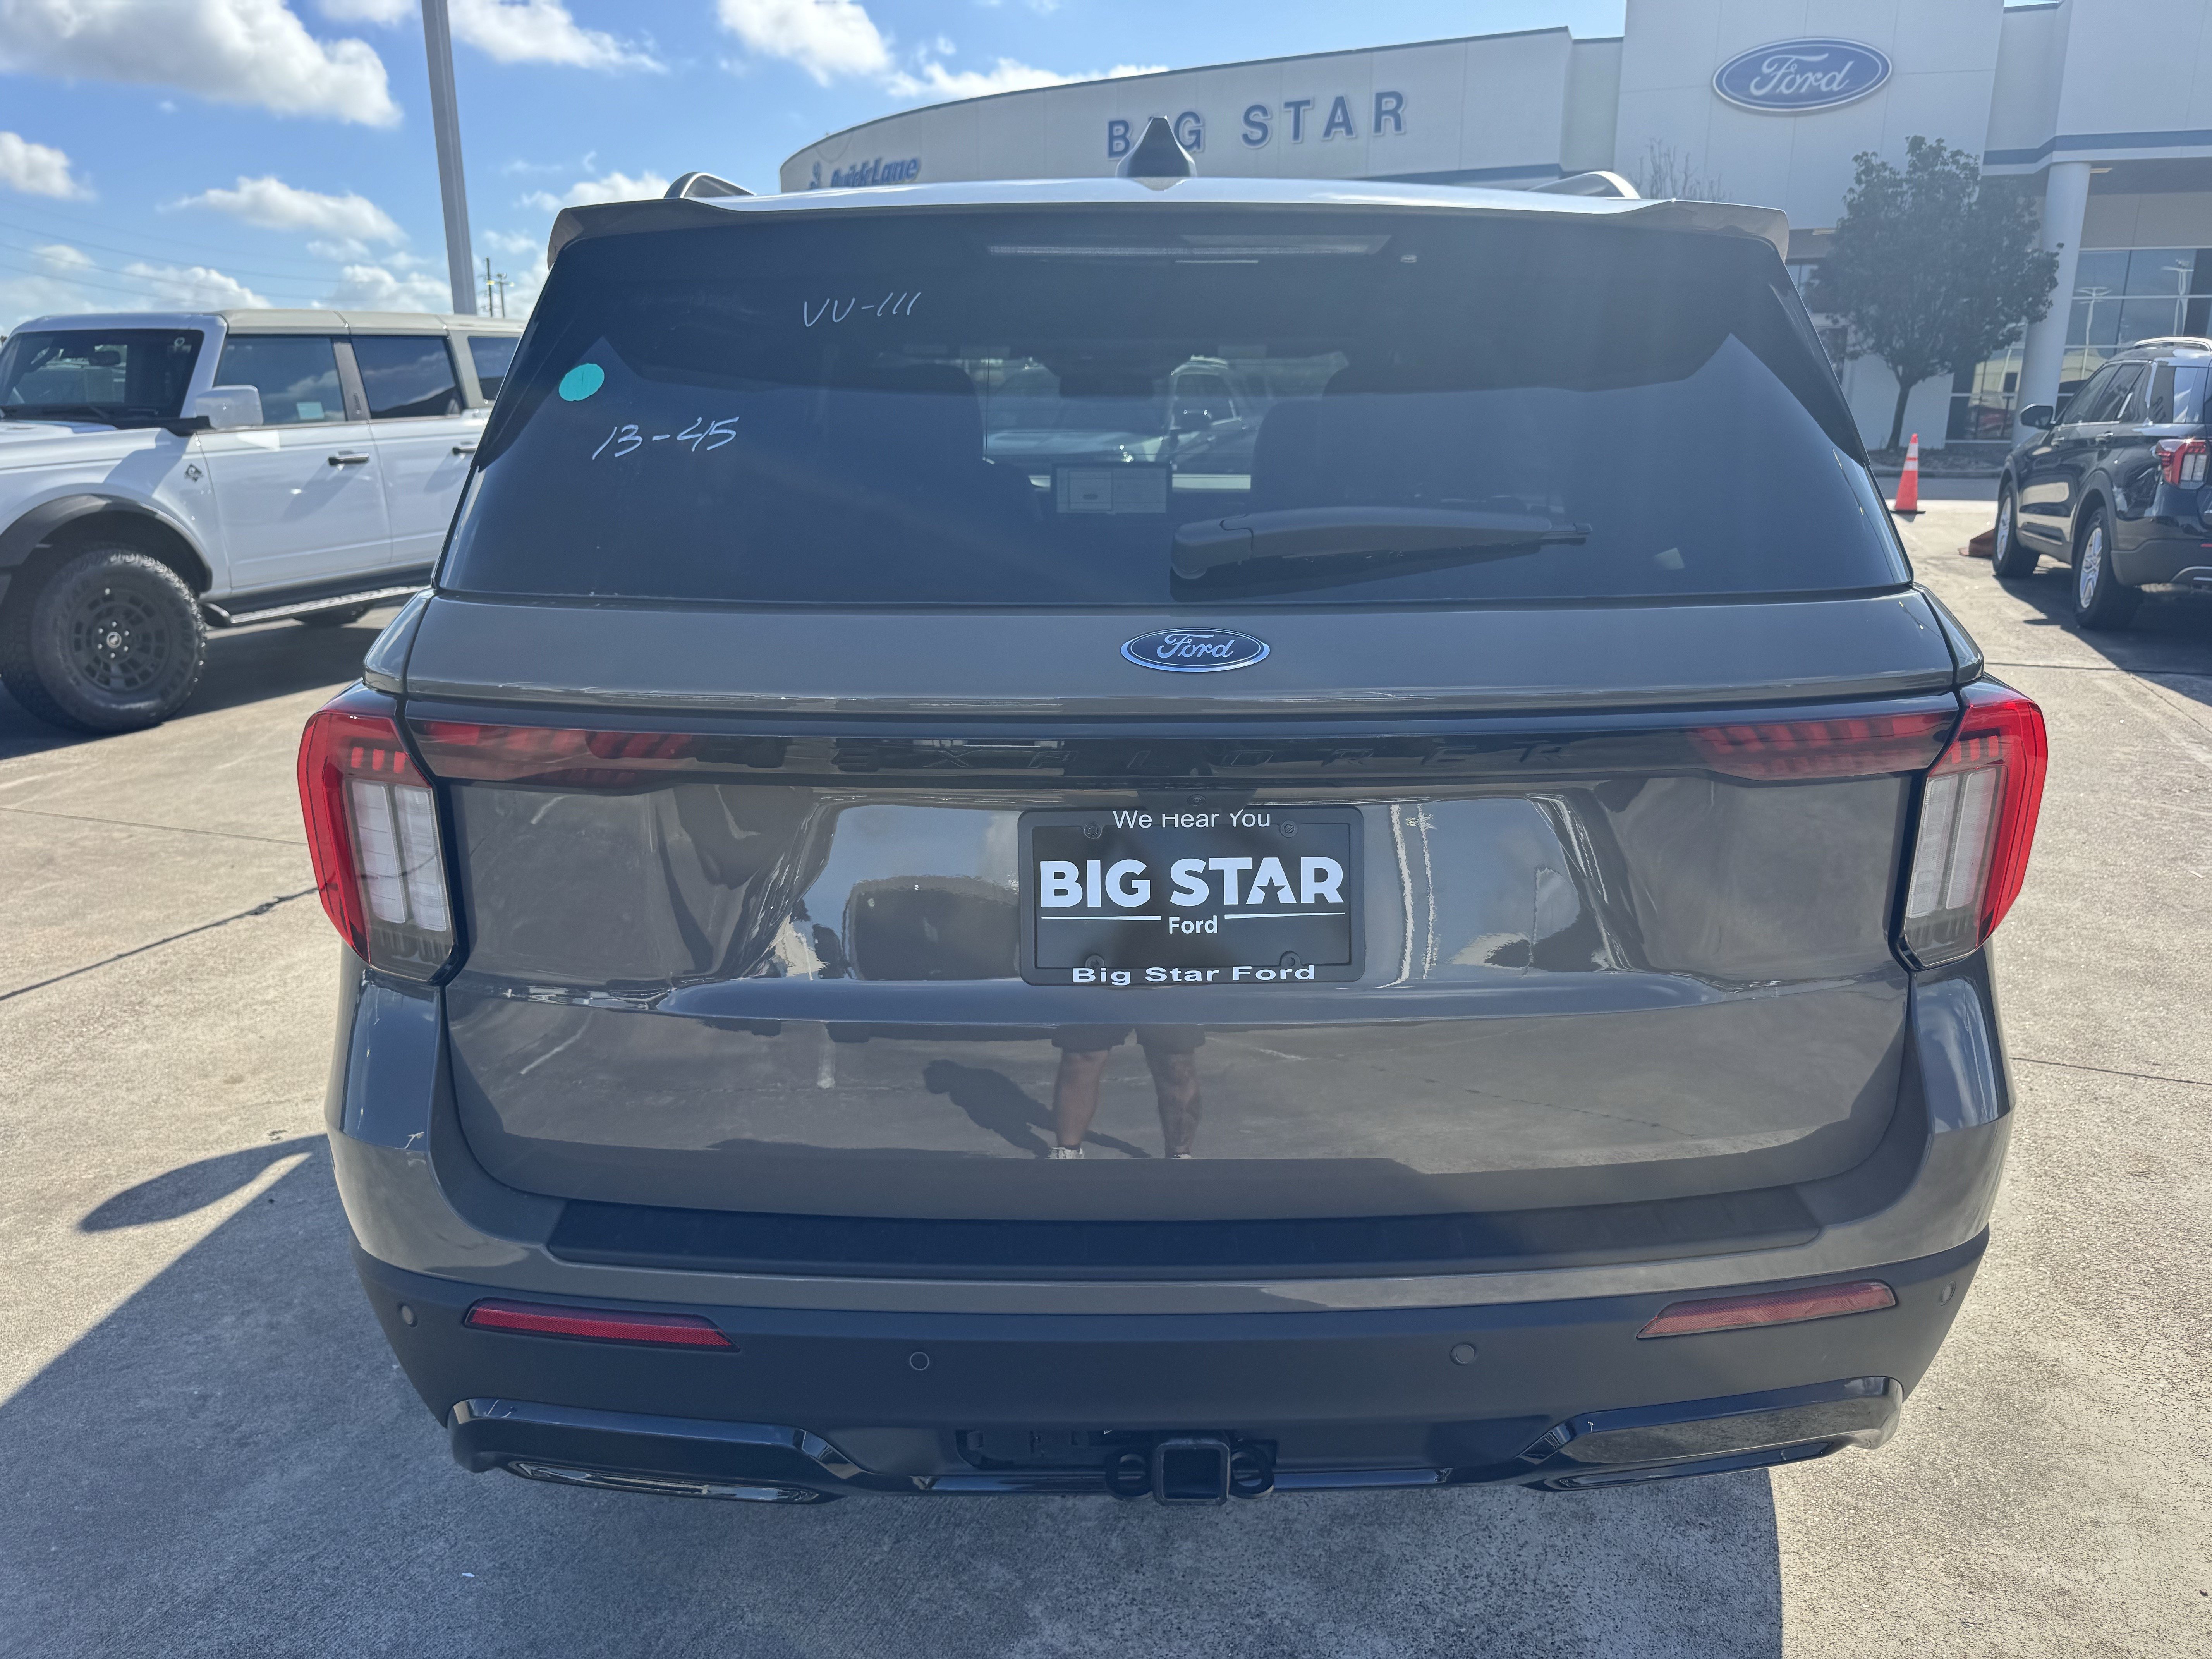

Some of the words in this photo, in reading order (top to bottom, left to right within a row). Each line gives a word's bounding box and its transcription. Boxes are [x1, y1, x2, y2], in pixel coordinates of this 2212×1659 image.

[1749, 53, 1855, 97] Ford
[1107, 111, 1204, 157] BG
[1241, 90, 1405, 148] STAR
[592, 417, 739, 460] 13-45
[1156, 633, 1235, 658] Ford
[1113, 810, 1152, 829] We
[1162, 813, 1219, 828] Hear
[1229, 809, 1271, 828] You
[1040, 859, 1151, 908] BIG
[1170, 856, 1344, 907] STAR
[1169, 915, 1218, 934] Ford
[1072, 968, 1131, 986] Big
[1145, 967, 1220, 982] Star
[1233, 965, 1315, 981] Ford
